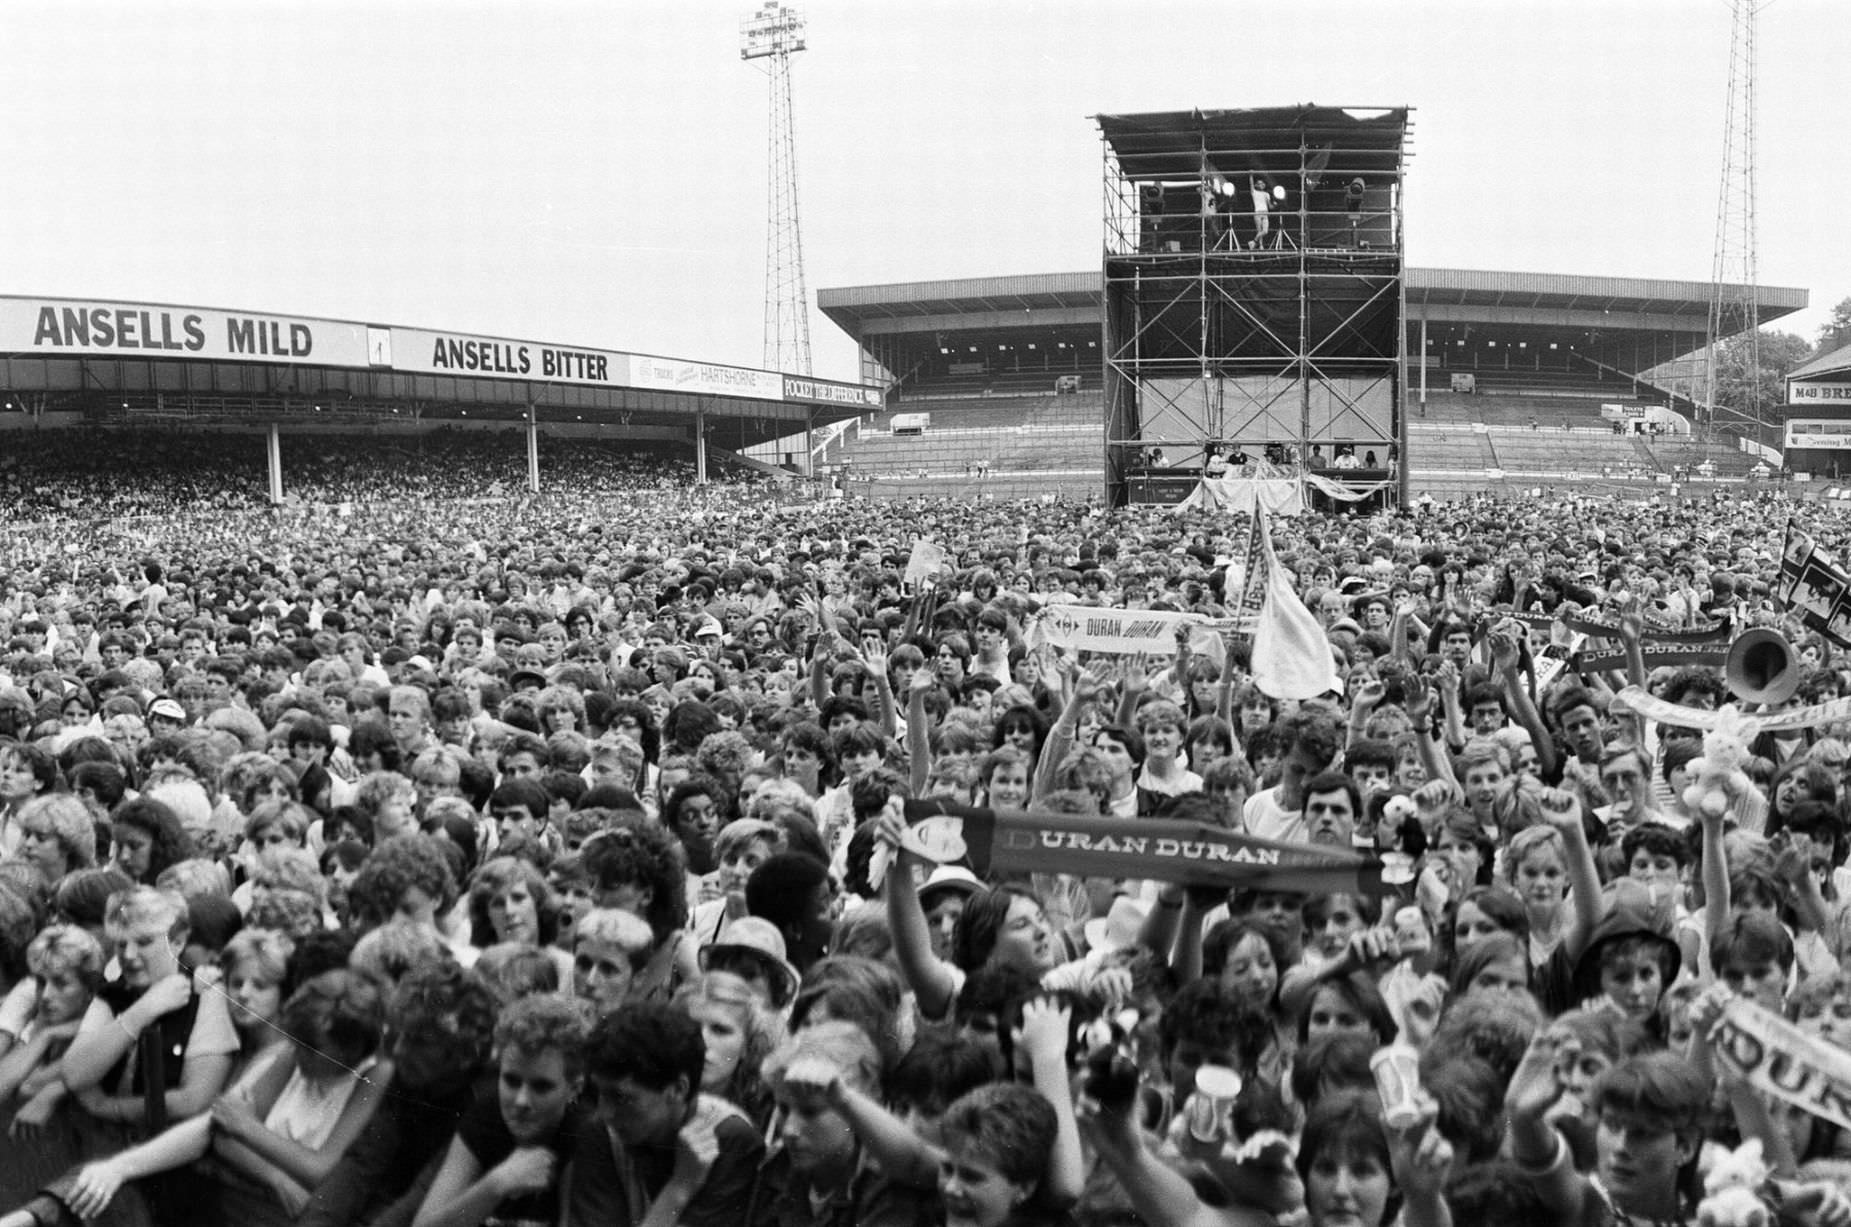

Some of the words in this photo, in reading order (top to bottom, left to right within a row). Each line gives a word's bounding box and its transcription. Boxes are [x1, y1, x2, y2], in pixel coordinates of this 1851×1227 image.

[34, 306, 206, 351] ANSELLS
[227, 317, 313, 357] MILD
[433, 337, 531, 374] ANSELLS
[541, 348, 608, 381] BITTER
[700, 367, 756, 387] HARTSHORNE
[1087, 618, 1122, 637] DURAN
[1122, 620, 1168, 639] DURAN
[1583, 649, 1626, 662] DURA
[1645, 645, 1702, 654] DURAN
[1008, 829, 1150, 854] DURAN
[1155, 837, 1281, 865] DURAN
